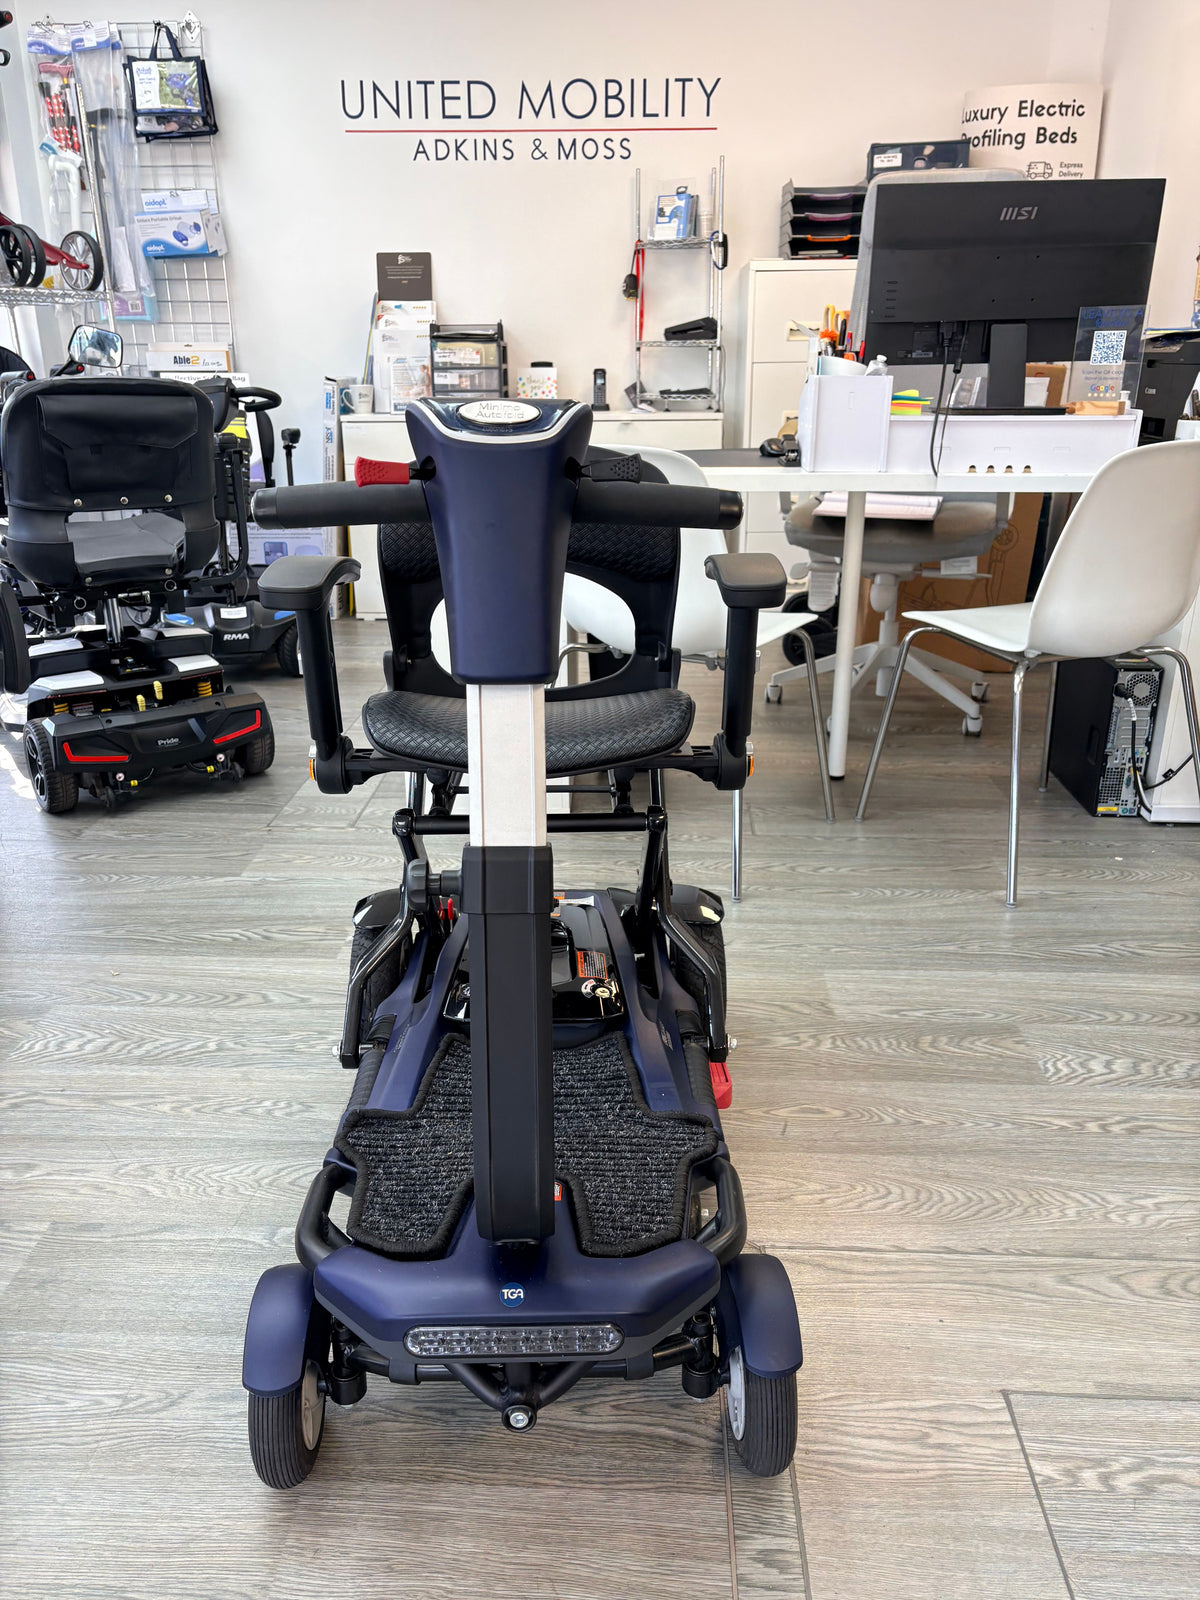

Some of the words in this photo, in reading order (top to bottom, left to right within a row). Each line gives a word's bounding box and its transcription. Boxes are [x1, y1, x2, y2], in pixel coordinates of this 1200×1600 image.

[341, 80, 496, 119] UNITED
[518, 77, 721, 119] MOBILITY
[1018, 99, 1086, 117] Electric
[1036, 126, 1078, 144] Beds
[413, 138, 514, 161] ADKINS
[531, 138, 548, 160] &
[557, 138, 631, 160] MOSS
[1060, 161, 1083, 169] Express
[1000, 206, 1038, 220] MSI
[173, 356, 200, 365] Able2
[1090, 384, 1115, 393] Google
[479, 402, 521, 411] Minimo
[475, 411, 525, 419] Autofold
[223, 633, 250, 641] RMA
[501, 1288, 524, 1300] TGA
